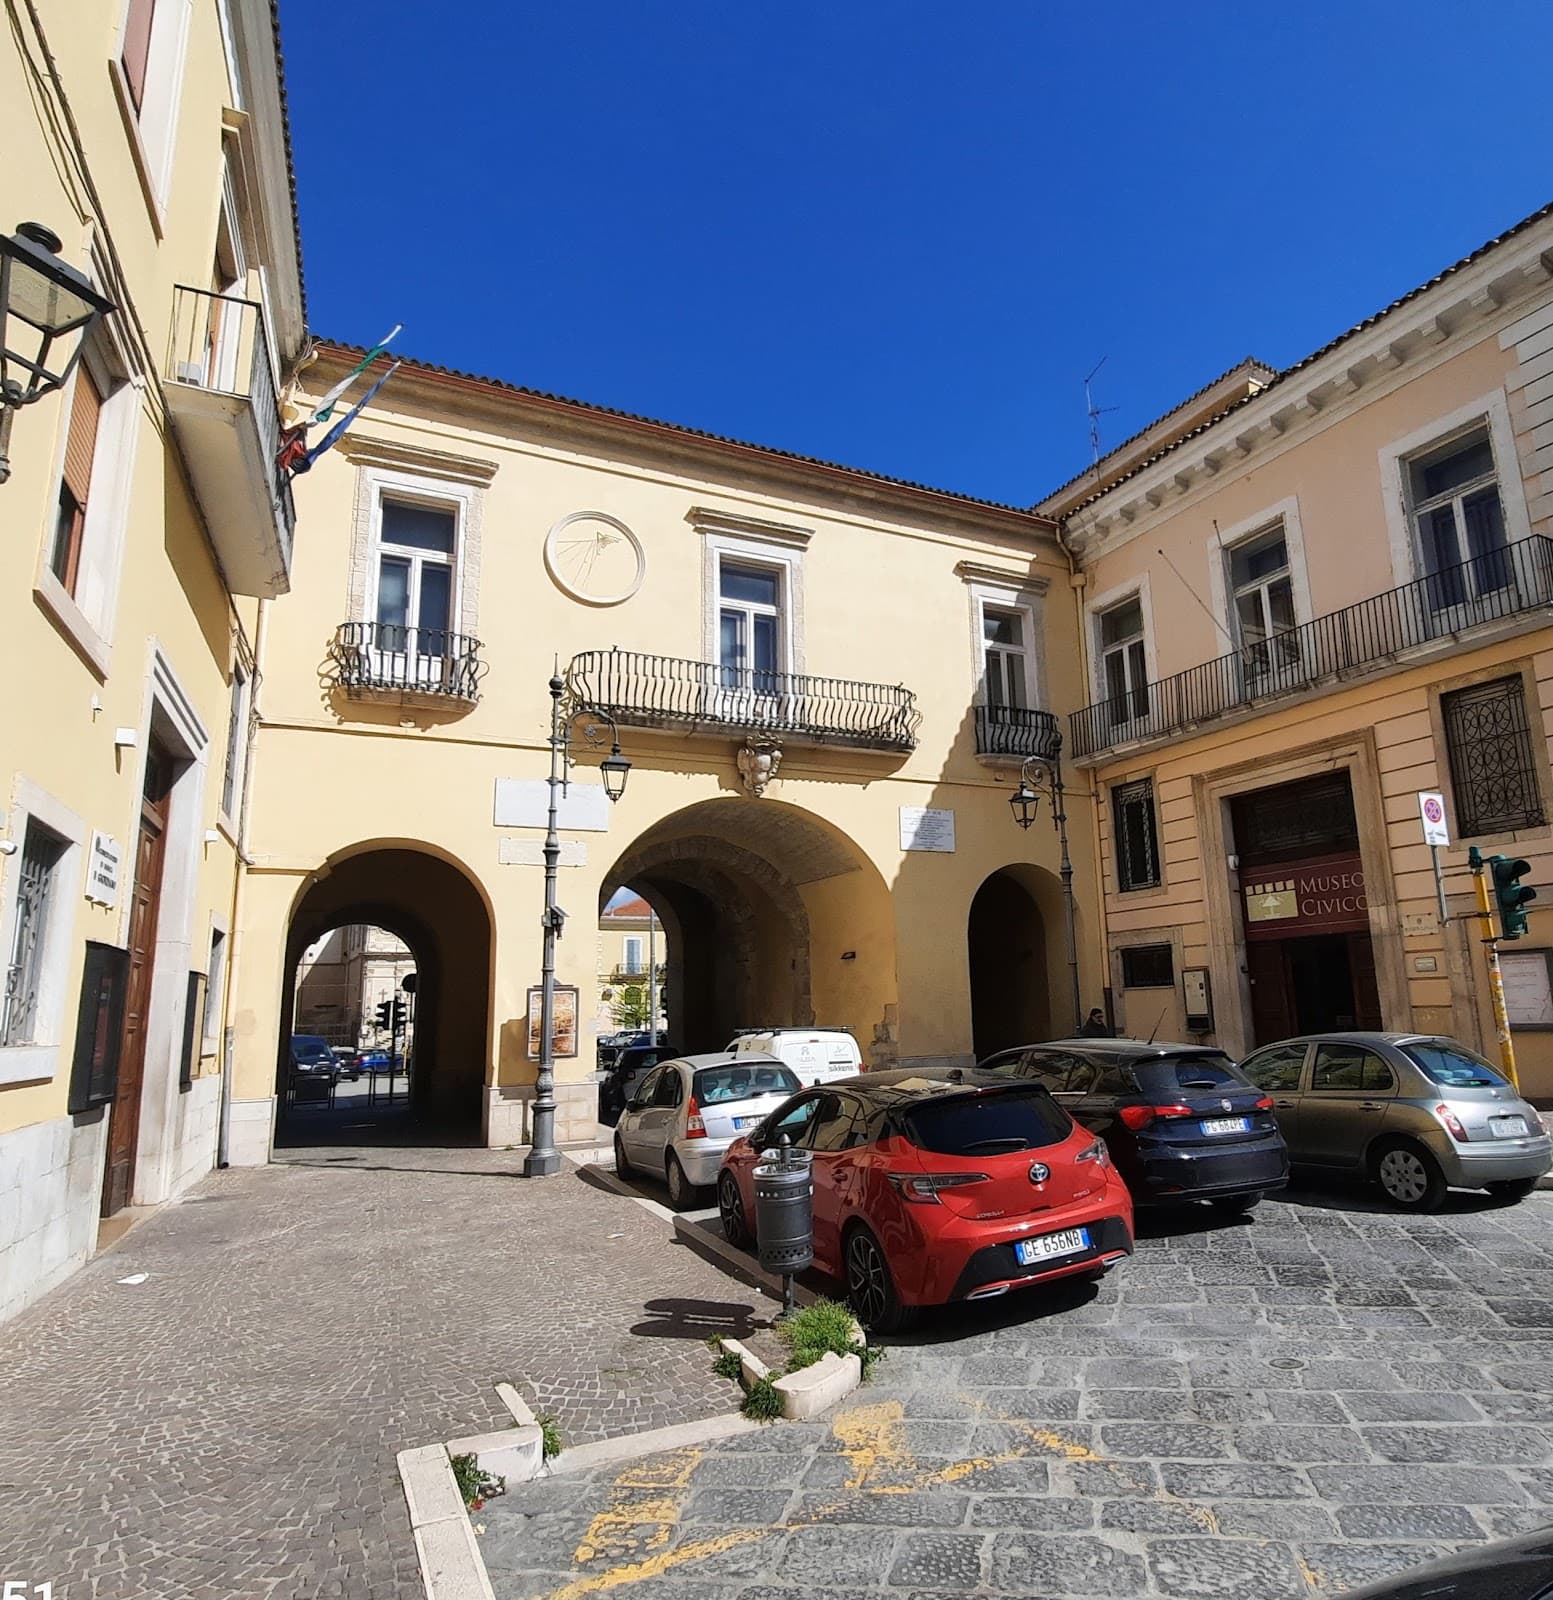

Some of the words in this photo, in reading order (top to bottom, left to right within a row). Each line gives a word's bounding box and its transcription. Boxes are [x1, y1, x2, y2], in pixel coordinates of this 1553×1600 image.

[1300, 872, 1364, 894] MUSEO
[1302, 895, 1368, 916] CIVICO
[1024, 1241, 1041, 1258] GE
[1043, 1230, 1080, 1253] 656NB
